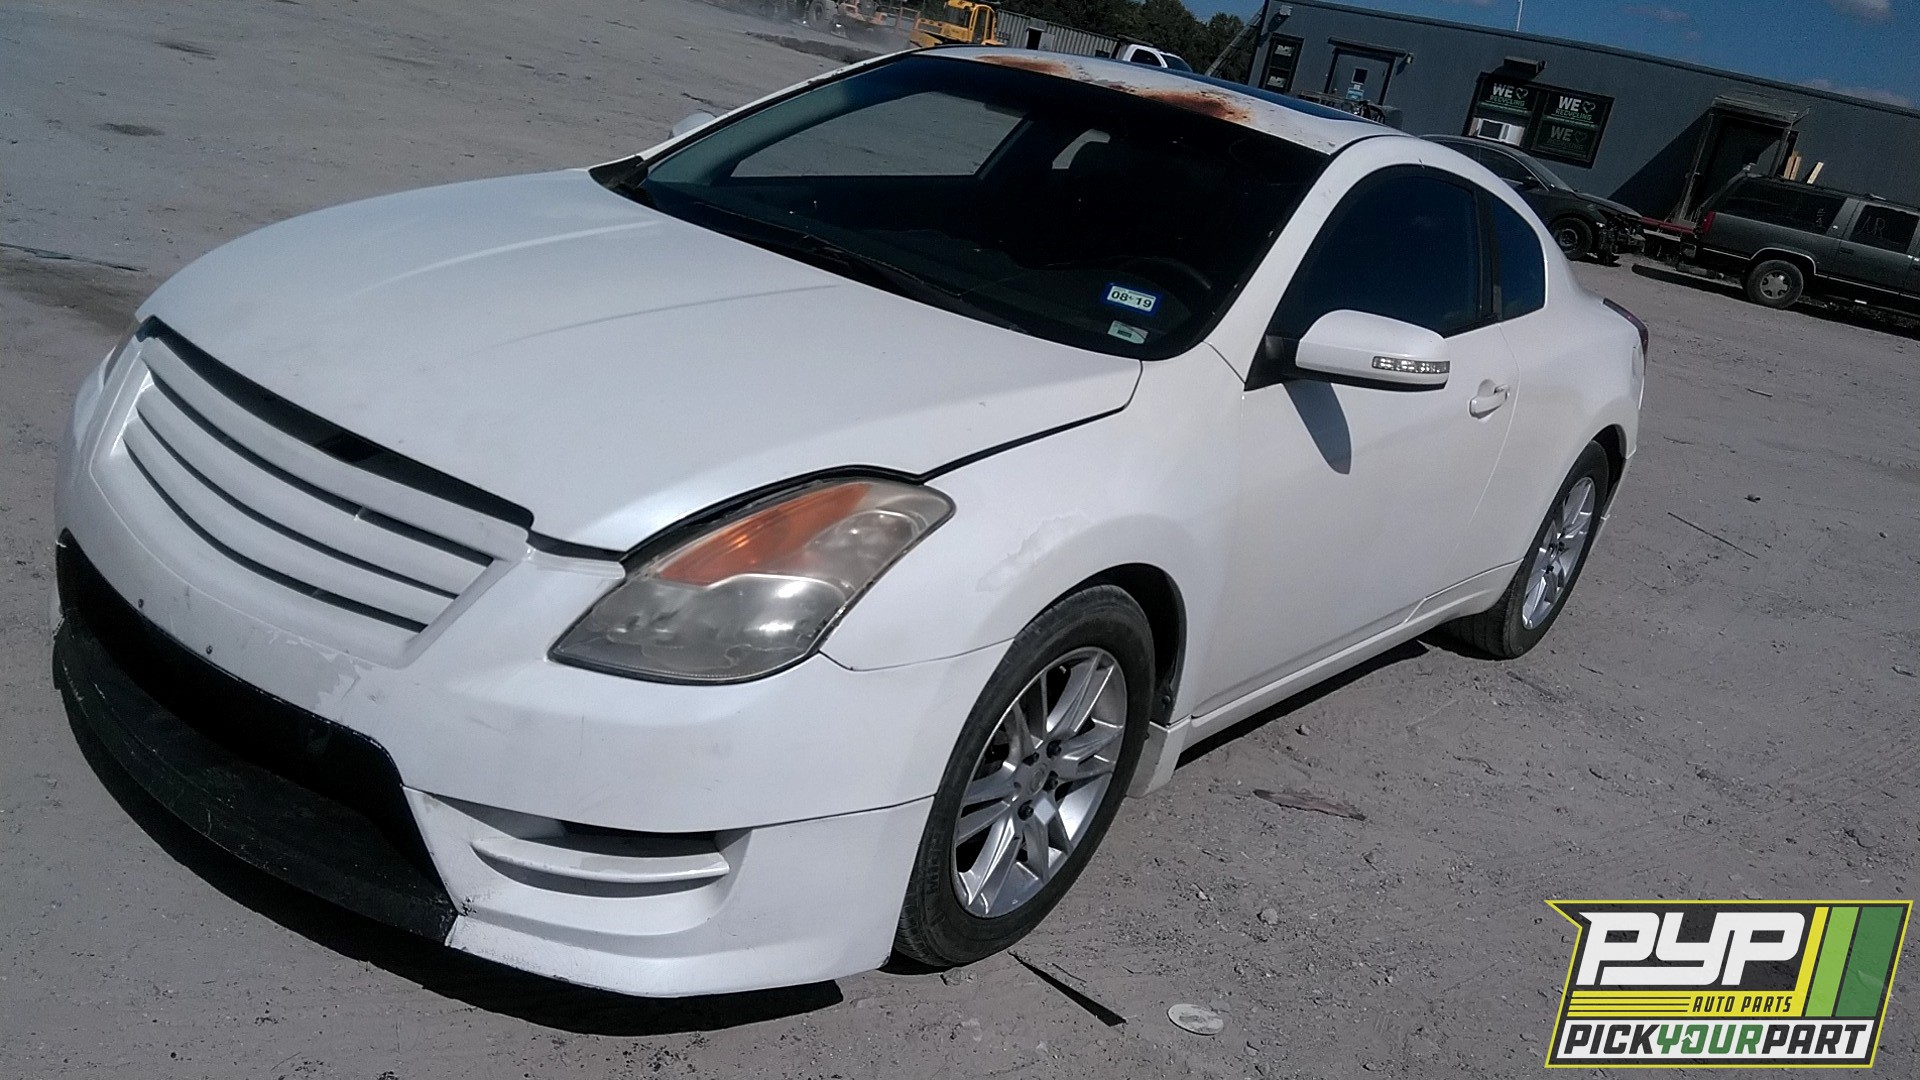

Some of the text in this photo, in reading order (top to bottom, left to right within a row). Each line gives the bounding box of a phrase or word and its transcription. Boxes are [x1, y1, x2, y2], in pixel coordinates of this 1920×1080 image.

[1492, 83, 1515, 98] WE
[1489, 94, 1526, 107] RECYCLING
[1558, 95, 1582, 112] WE
[1555, 108, 1593, 121] RECYCLING
[1551, 125, 1574, 142] WE
[1111, 290, 1129, 302] 08
[1136, 297, 1152, 308] 19
